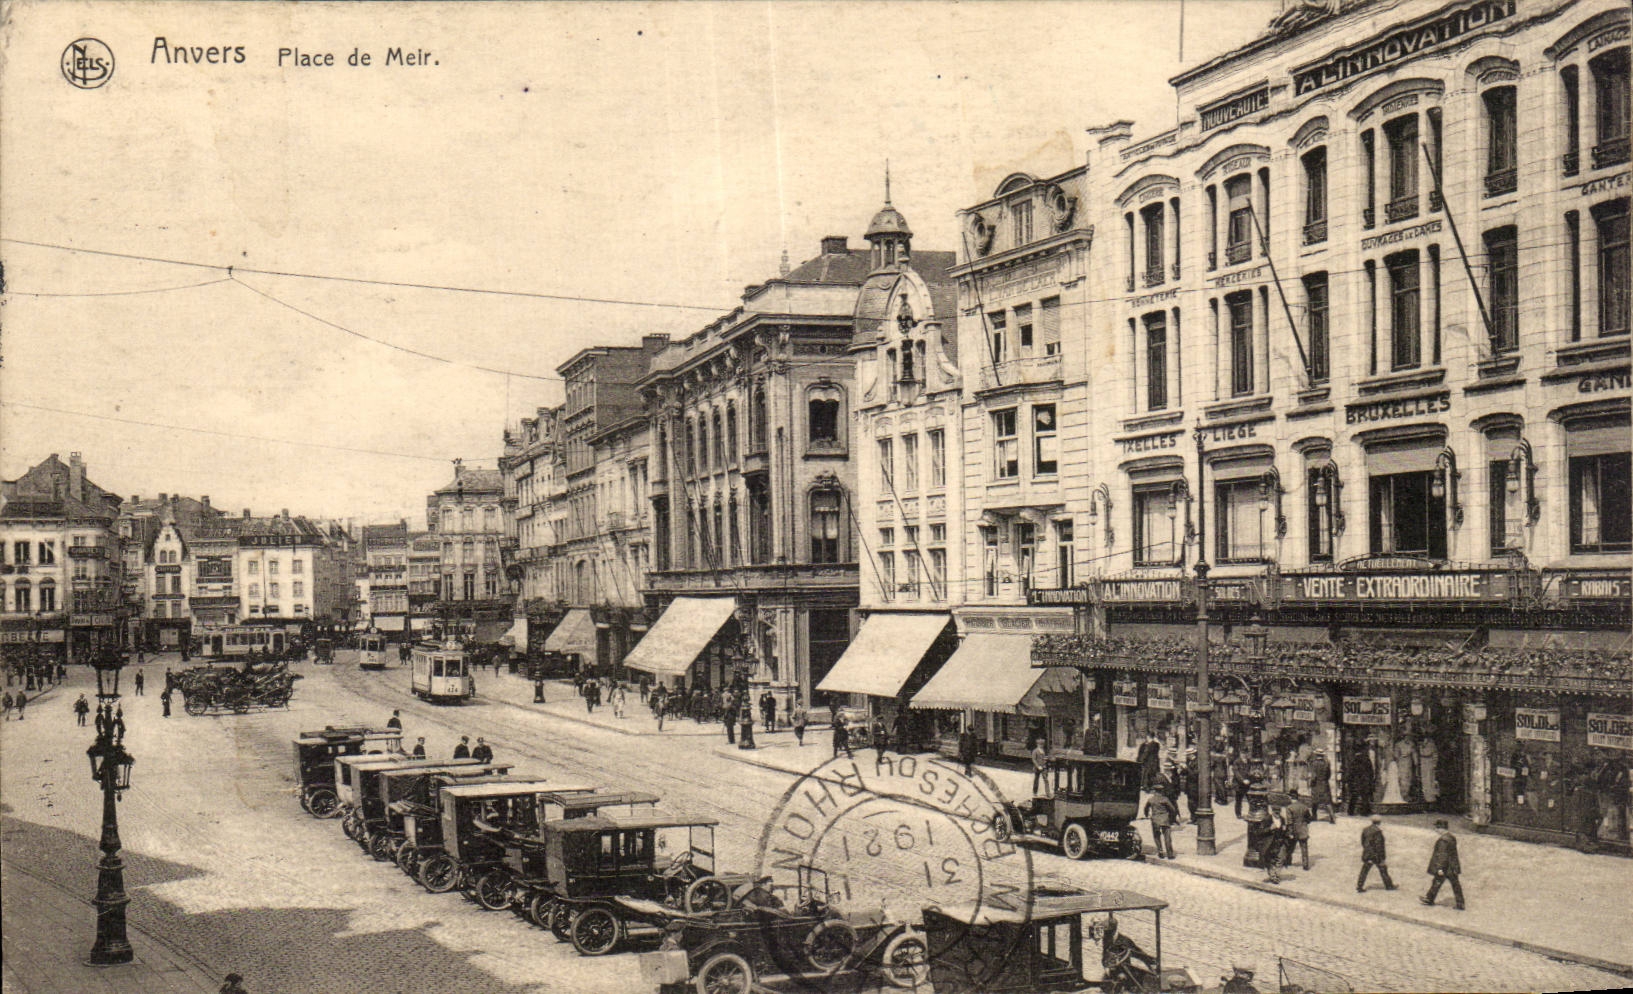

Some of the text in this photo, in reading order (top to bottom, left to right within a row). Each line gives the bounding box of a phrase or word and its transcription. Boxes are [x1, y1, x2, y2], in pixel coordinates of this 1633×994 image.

[1345, 395, 1450, 424] BRUXELLES
[1123, 436, 1176, 454] IXELLES
[1303, 575, 1481, 598] VENTE EXTRAORDINAIRE
[1581, 581, 1620, 596] RABAIS
